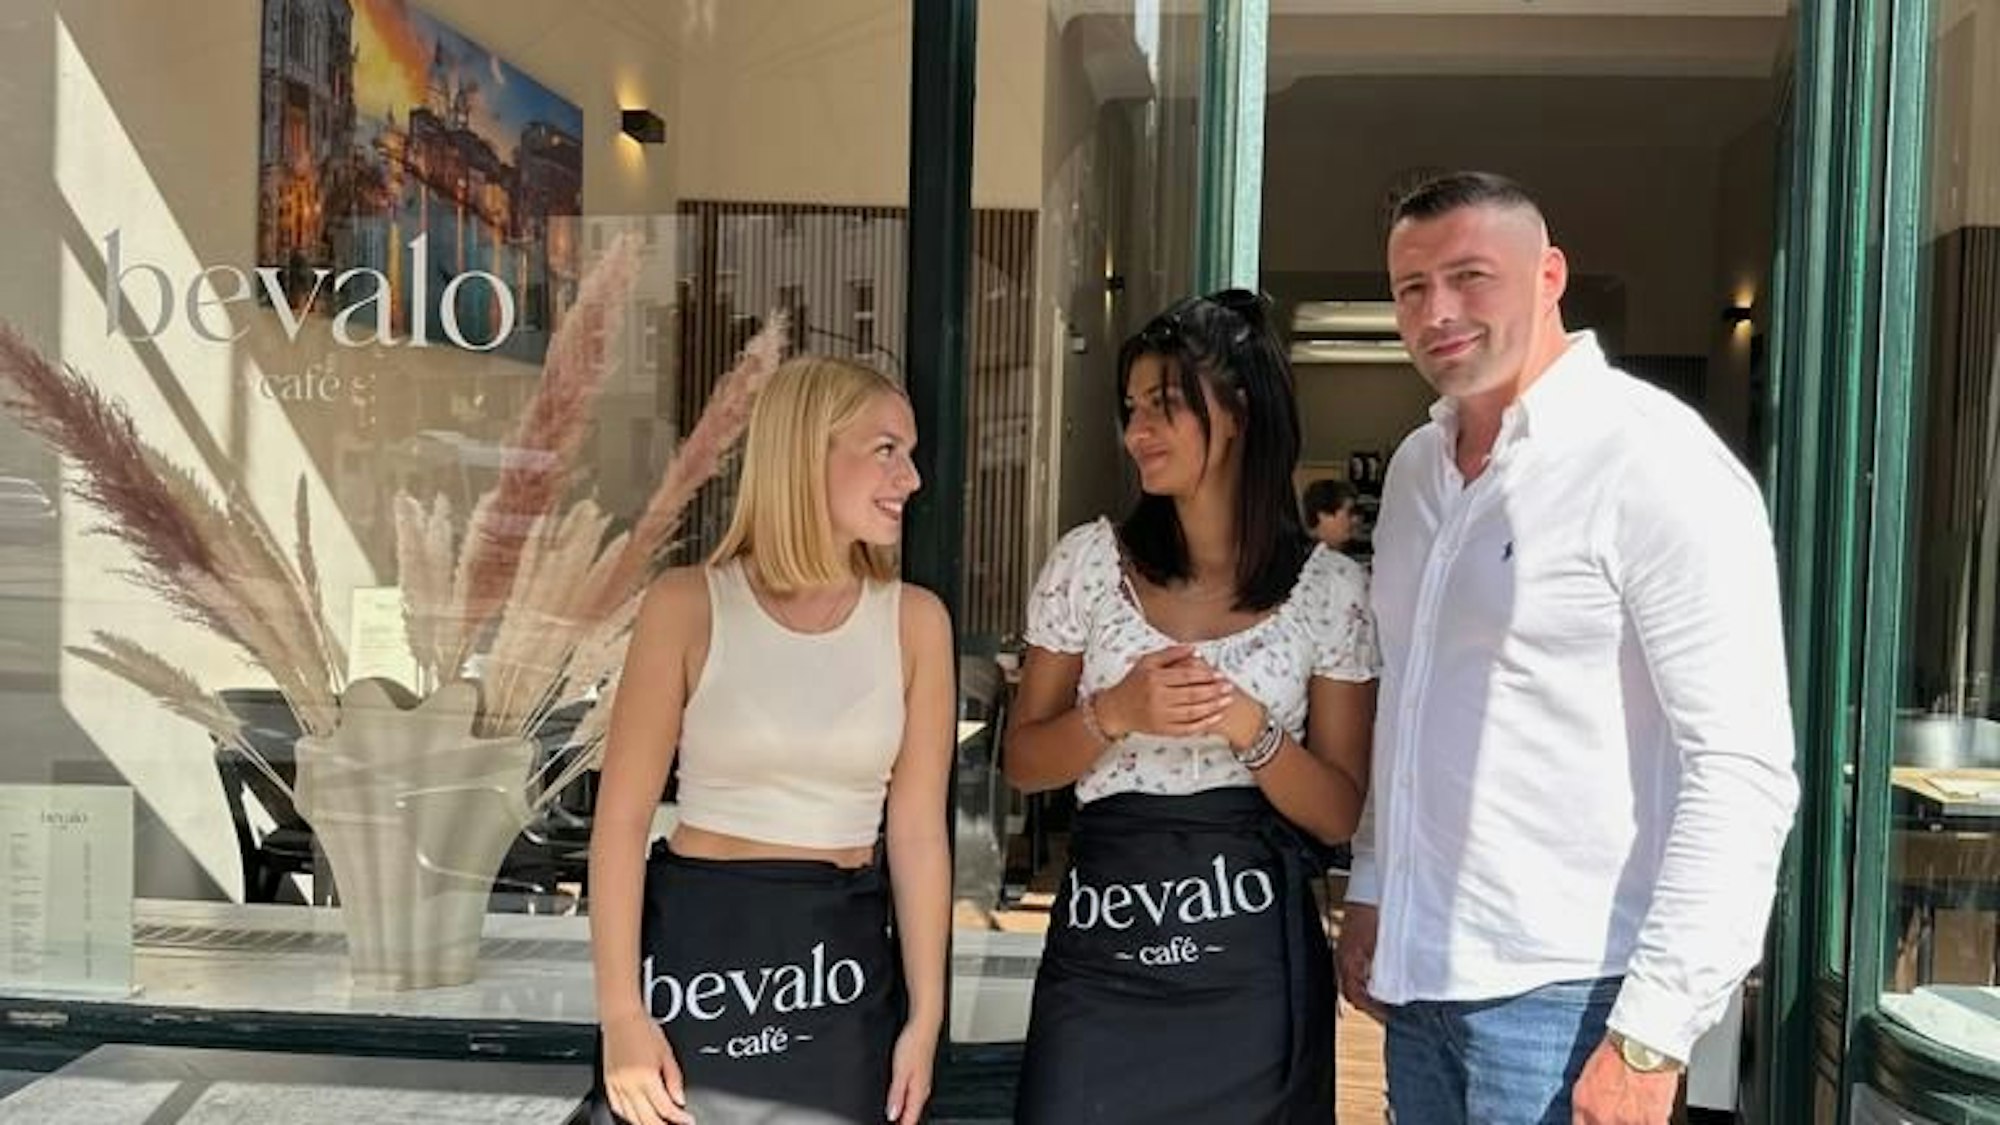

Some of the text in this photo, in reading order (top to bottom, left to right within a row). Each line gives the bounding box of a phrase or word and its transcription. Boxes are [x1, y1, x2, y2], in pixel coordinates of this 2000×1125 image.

[103, 228, 516, 351] bevalo
[257, 363, 341, 400] café
[1067, 853, 1275, 930] bevalo
[1138, 935, 1200, 965] café
[643, 941, 866, 1024] bevalo
[727, 1025, 789, 1058] café
